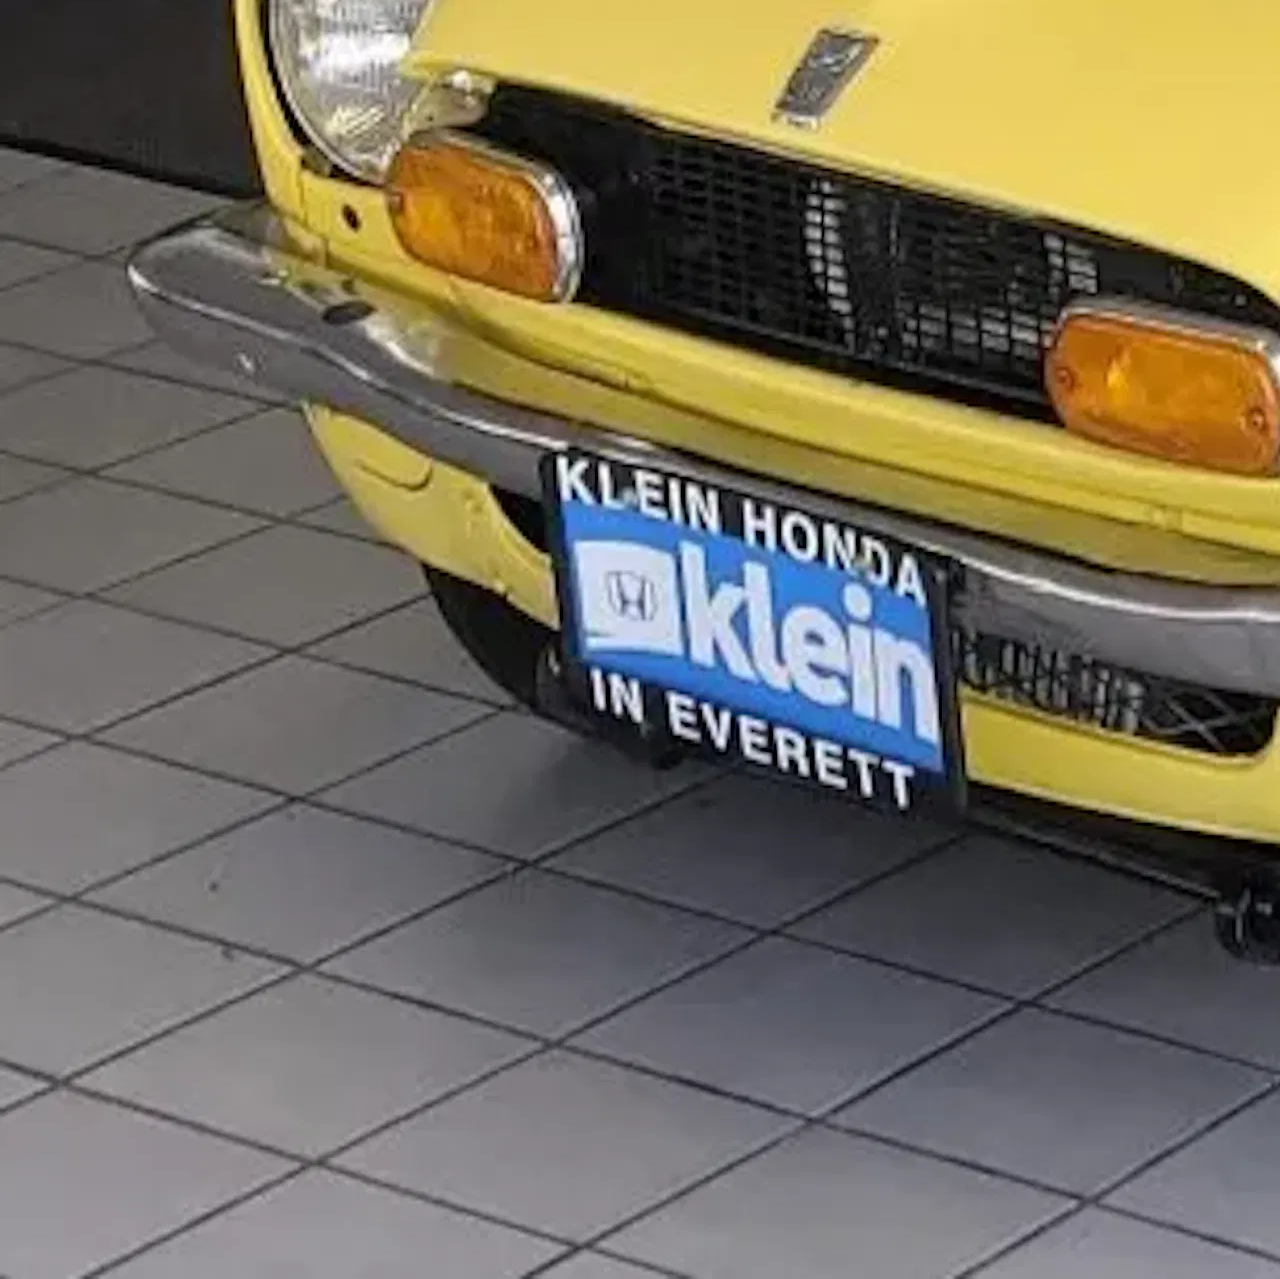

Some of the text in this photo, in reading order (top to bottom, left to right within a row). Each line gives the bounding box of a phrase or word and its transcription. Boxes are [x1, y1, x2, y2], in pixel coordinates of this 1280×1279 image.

[556, 455, 927, 606] KLEIN HONDA
[678, 540, 940, 743] klein
[590, 669, 915, 809] IN EVERETT
